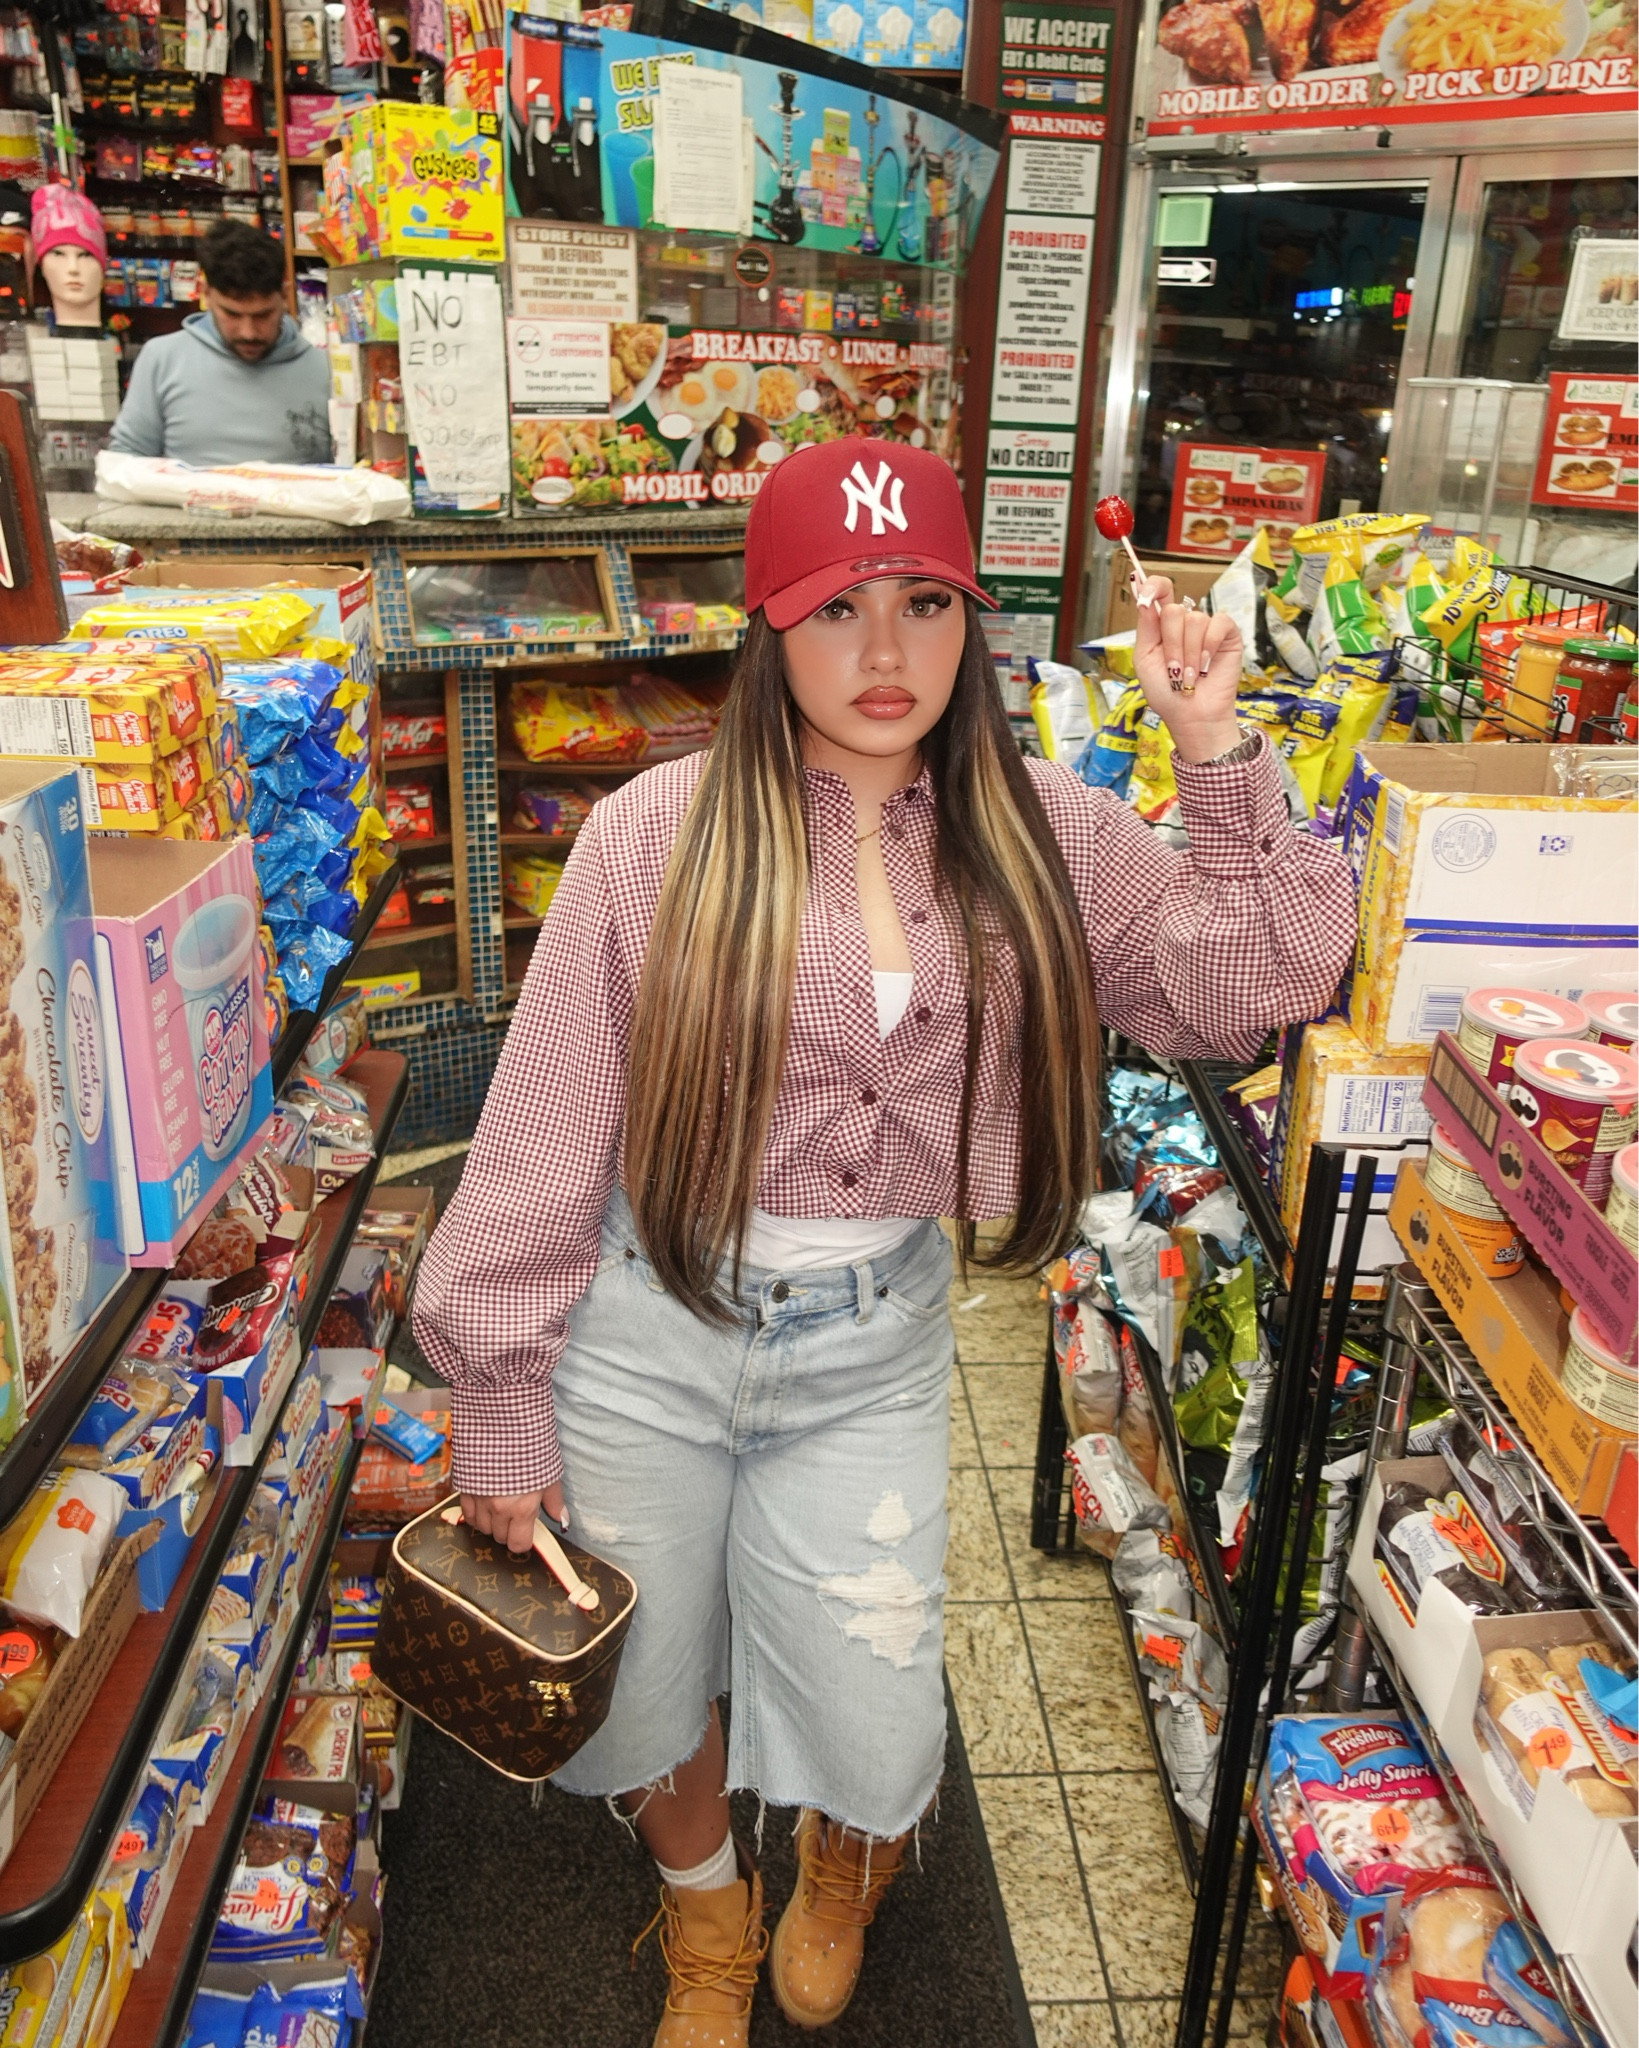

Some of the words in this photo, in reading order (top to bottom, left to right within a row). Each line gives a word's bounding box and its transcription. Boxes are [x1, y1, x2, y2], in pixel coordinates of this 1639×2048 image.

[1004, 16, 1035, 44] WE
[1036, 18, 1110, 49] ACCEPT
[1002, 50, 1025, 68] EBT
[1025, 53, 1035, 69] &
[1036, 52, 1068, 70] Debit
[1069, 54, 1106, 73] Cards
[613, 65, 645, 92] WE
[1158, 84, 1262, 118] MOBILE
[1272, 76, 1370, 110] ORDER
[1405, 68, 1484, 101] PICK
[1492, 63, 1542, 94] UP
[1546, 56, 1633, 92] LINE
[480, 114, 498, 128] 42
[1011, 114, 1105, 137] WARNING
[517, 226, 571, 243] STORE
[573, 231, 627, 248] POLICY
[1008, 230, 1087, 249] PROHIBITED
[541, 247, 558, 261] NO
[412, 290, 463, 332] NO
[407, 340, 467, 367] EBT
[692, 331, 825, 363] BREAKFAST
[842, 338, 898, 366] LUNCH
[1000, 351, 1076, 369] PROHIBITED
[525, 370, 540, 379] The
[560, 371, 588, 381] system
[525, 384, 572, 394] temporarily
[574, 385, 596, 393] down.
[413, 383, 458, 407] NO
[990, 448, 1011, 466] NO
[1016, 449, 1071, 469] CREDIT
[623, 473, 708, 503] MOBIL
[988, 483, 1024, 497] STORE
[1027, 485, 1066, 500] POLICY
[996, 506, 1009, 517] NO
[1011, 506, 1055, 519] REFUNDS
[1223, 494, 1305, 512] EMPANADAS
[1028, 557, 1060, 568] CARDS
[126, 626, 188, 639] OREO
[80, 699, 90, 731] Nutrition
[124, 710, 144, 746] Crunch
[111, 712, 132, 746] Munch
[60, 737, 69, 755] 150
[119, 780, 139, 814] Munch
[131, 778, 153, 814] Crunch
[67, 796, 79, 831] 30
[222, 984, 249, 1025] CLASSIC
[154, 1012, 169, 1032] FREE
[156, 1033, 171, 1055] NUT
[201, 1001, 249, 1110] COTTON
[159, 1052, 174, 1074] FREE
[36, 967, 66, 1113] Chocolate
[53, 1121, 73, 1199] Chip
[162, 1066, 185, 1098] GLUTEN
[1345, 1081, 1355, 1100] Facts
[163, 1093, 179, 1117] FREE
[1341, 1100, 1353, 1132] Nutrition
[1391, 1096, 1402, 1111] 140
[166, 1106, 190, 1139] PEANUT
[172, 1165, 194, 1222] 12
[1528, 1159, 1573, 1221] BURSTING
[1524, 1187, 1566, 1248] FLAVOR
[1437, 1231, 1473, 1290] BURSTING
[1431, 1256, 1466, 1315] FLAVOR
[154, 1420, 199, 1502] Danish
[1330, 1726, 1403, 1756] Freshley's
[326, 1760, 346, 1779] PIE
[1337, 1769, 1382, 1792] Jelly
[1384, 1764, 1432, 1783] Swirl
[1366, 1788, 1399, 1801] Honey
[1400, 1786, 1422, 1797] Bun
